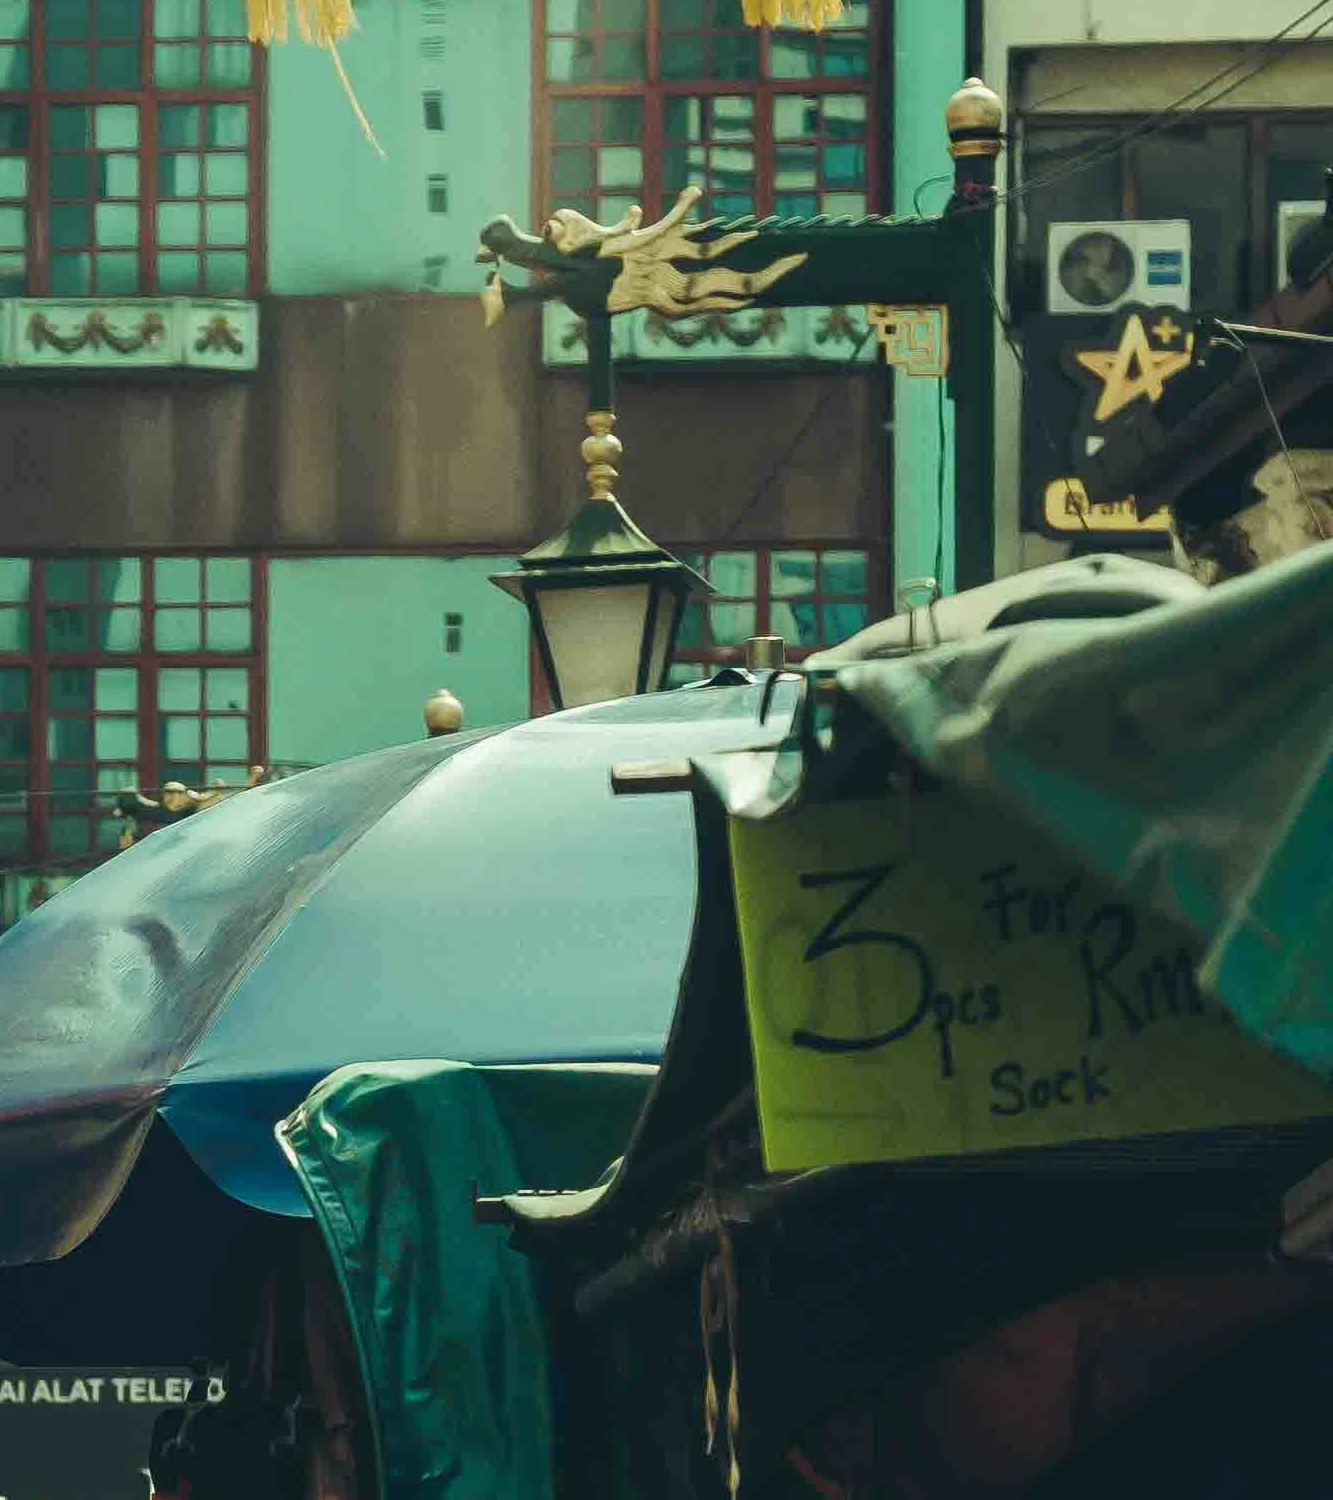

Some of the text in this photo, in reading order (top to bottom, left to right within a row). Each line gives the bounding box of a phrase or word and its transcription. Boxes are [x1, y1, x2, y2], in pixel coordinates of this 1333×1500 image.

[789, 860, 933, 1054] 3
[988, 1056, 1113, 1116] Sock
[31, 1378, 104, 1404] ALAT
